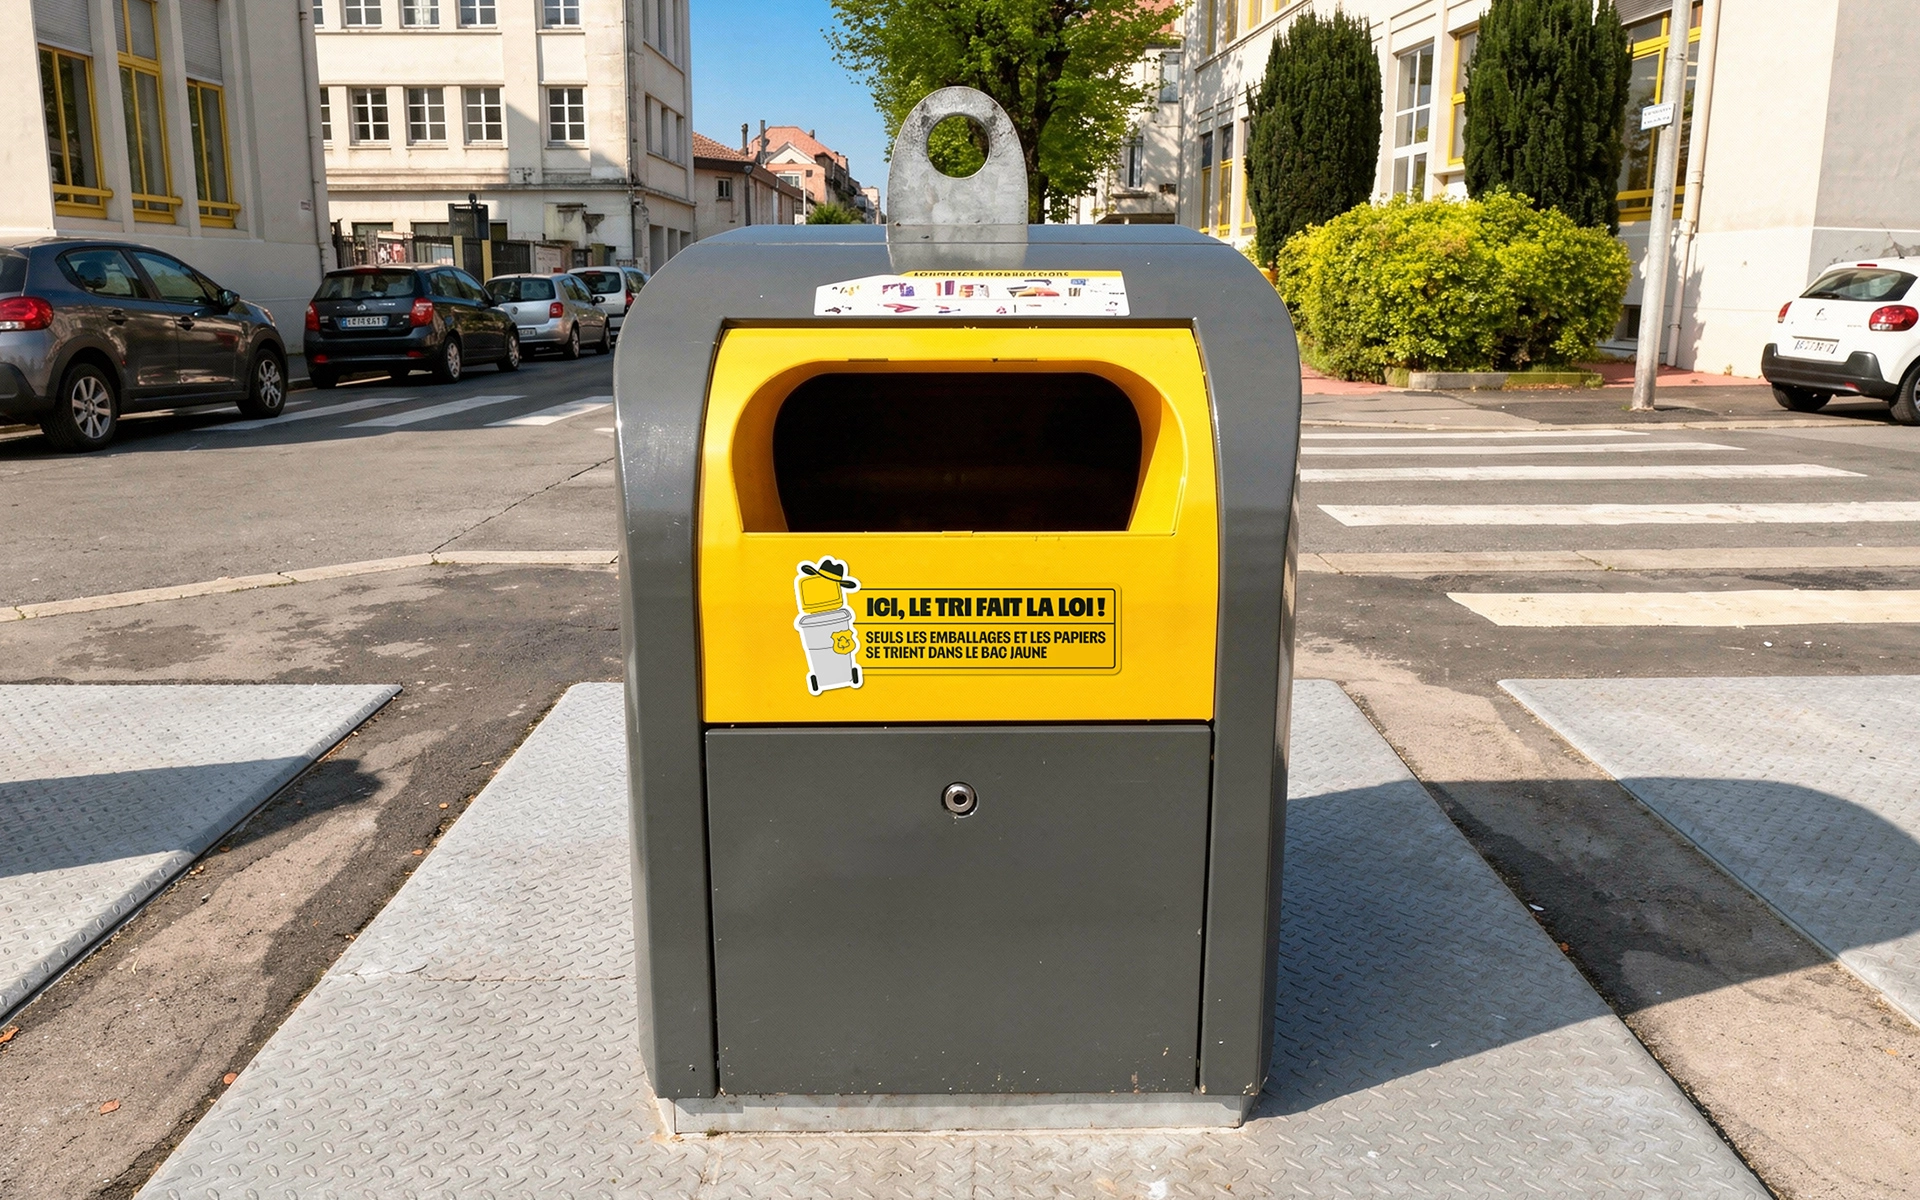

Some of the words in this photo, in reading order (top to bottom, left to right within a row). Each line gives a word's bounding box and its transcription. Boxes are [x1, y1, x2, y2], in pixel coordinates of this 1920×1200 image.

[867, 597, 905, 620] ICI,
[908, 597, 931, 617] LE
[935, 597, 971, 617] TRI
[977, 597, 1022, 617] FAIT
[1027, 597, 1054, 617] LA
[866, 630, 904, 644] SEULS
[907, 630, 928, 644] LES
[930, 630, 1011, 644] EMBALLAGES
[1014, 630, 1028, 644] ET
[1031, 630, 1051, 644] LES
[1054, 630, 1107, 644] PAPIERS
[866, 646, 881, 659] SE
[883, 646, 926, 659] TRIENT
[929, 646, 963, 659] DANS
[966, 646, 979, 659] LE
[982, 646, 1007, 659] BAC
[1010, 646, 1048, 660] JAUNE
